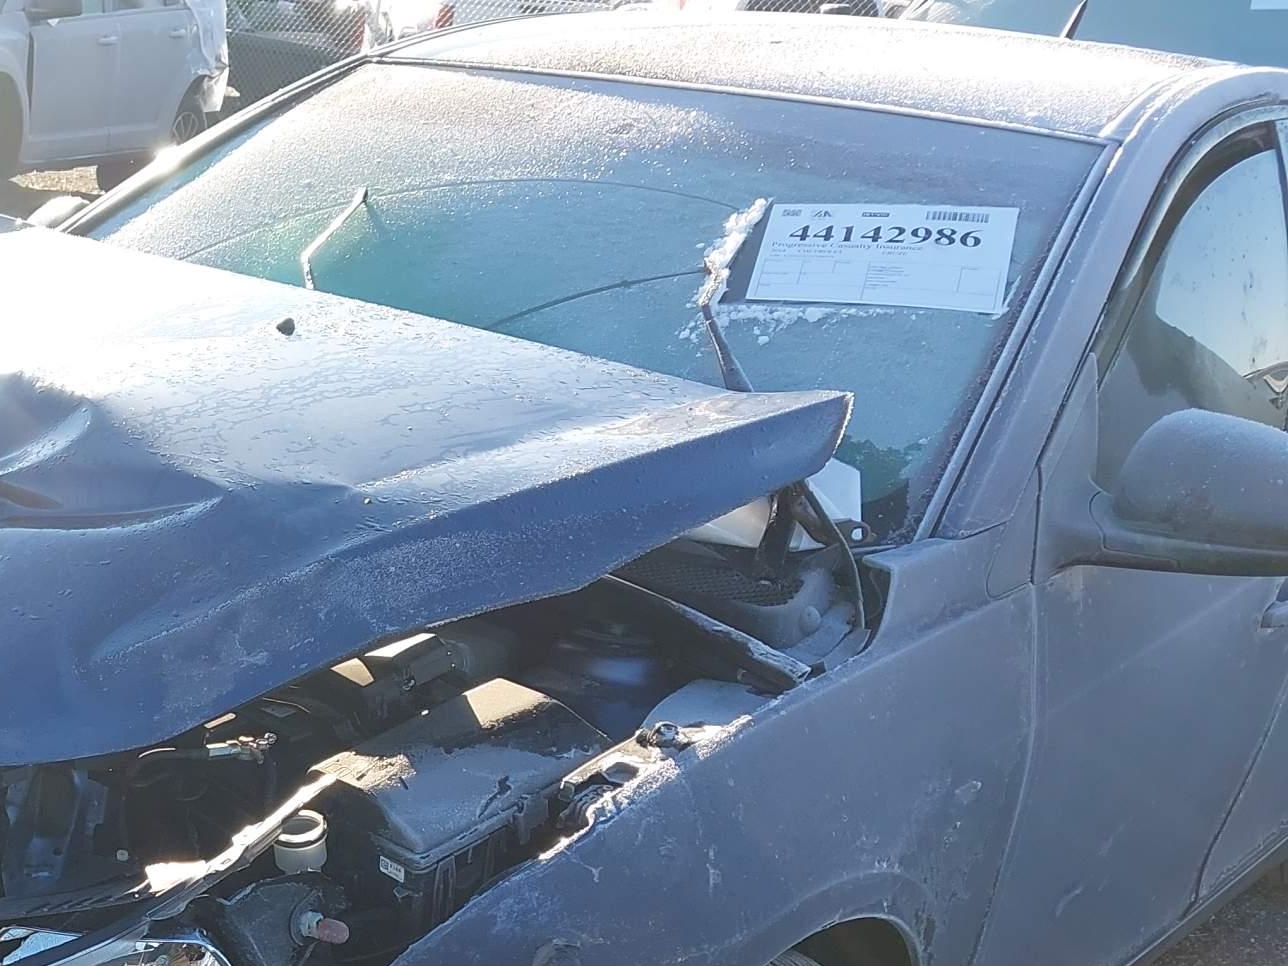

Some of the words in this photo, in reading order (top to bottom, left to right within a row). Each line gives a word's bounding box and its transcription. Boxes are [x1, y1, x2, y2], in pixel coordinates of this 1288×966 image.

[789, 224, 984, 248] 44142986
[771, 241, 828, 250] Progressive
[830, 242, 872, 250] Casualty
[875, 243, 924, 251] Insurance
